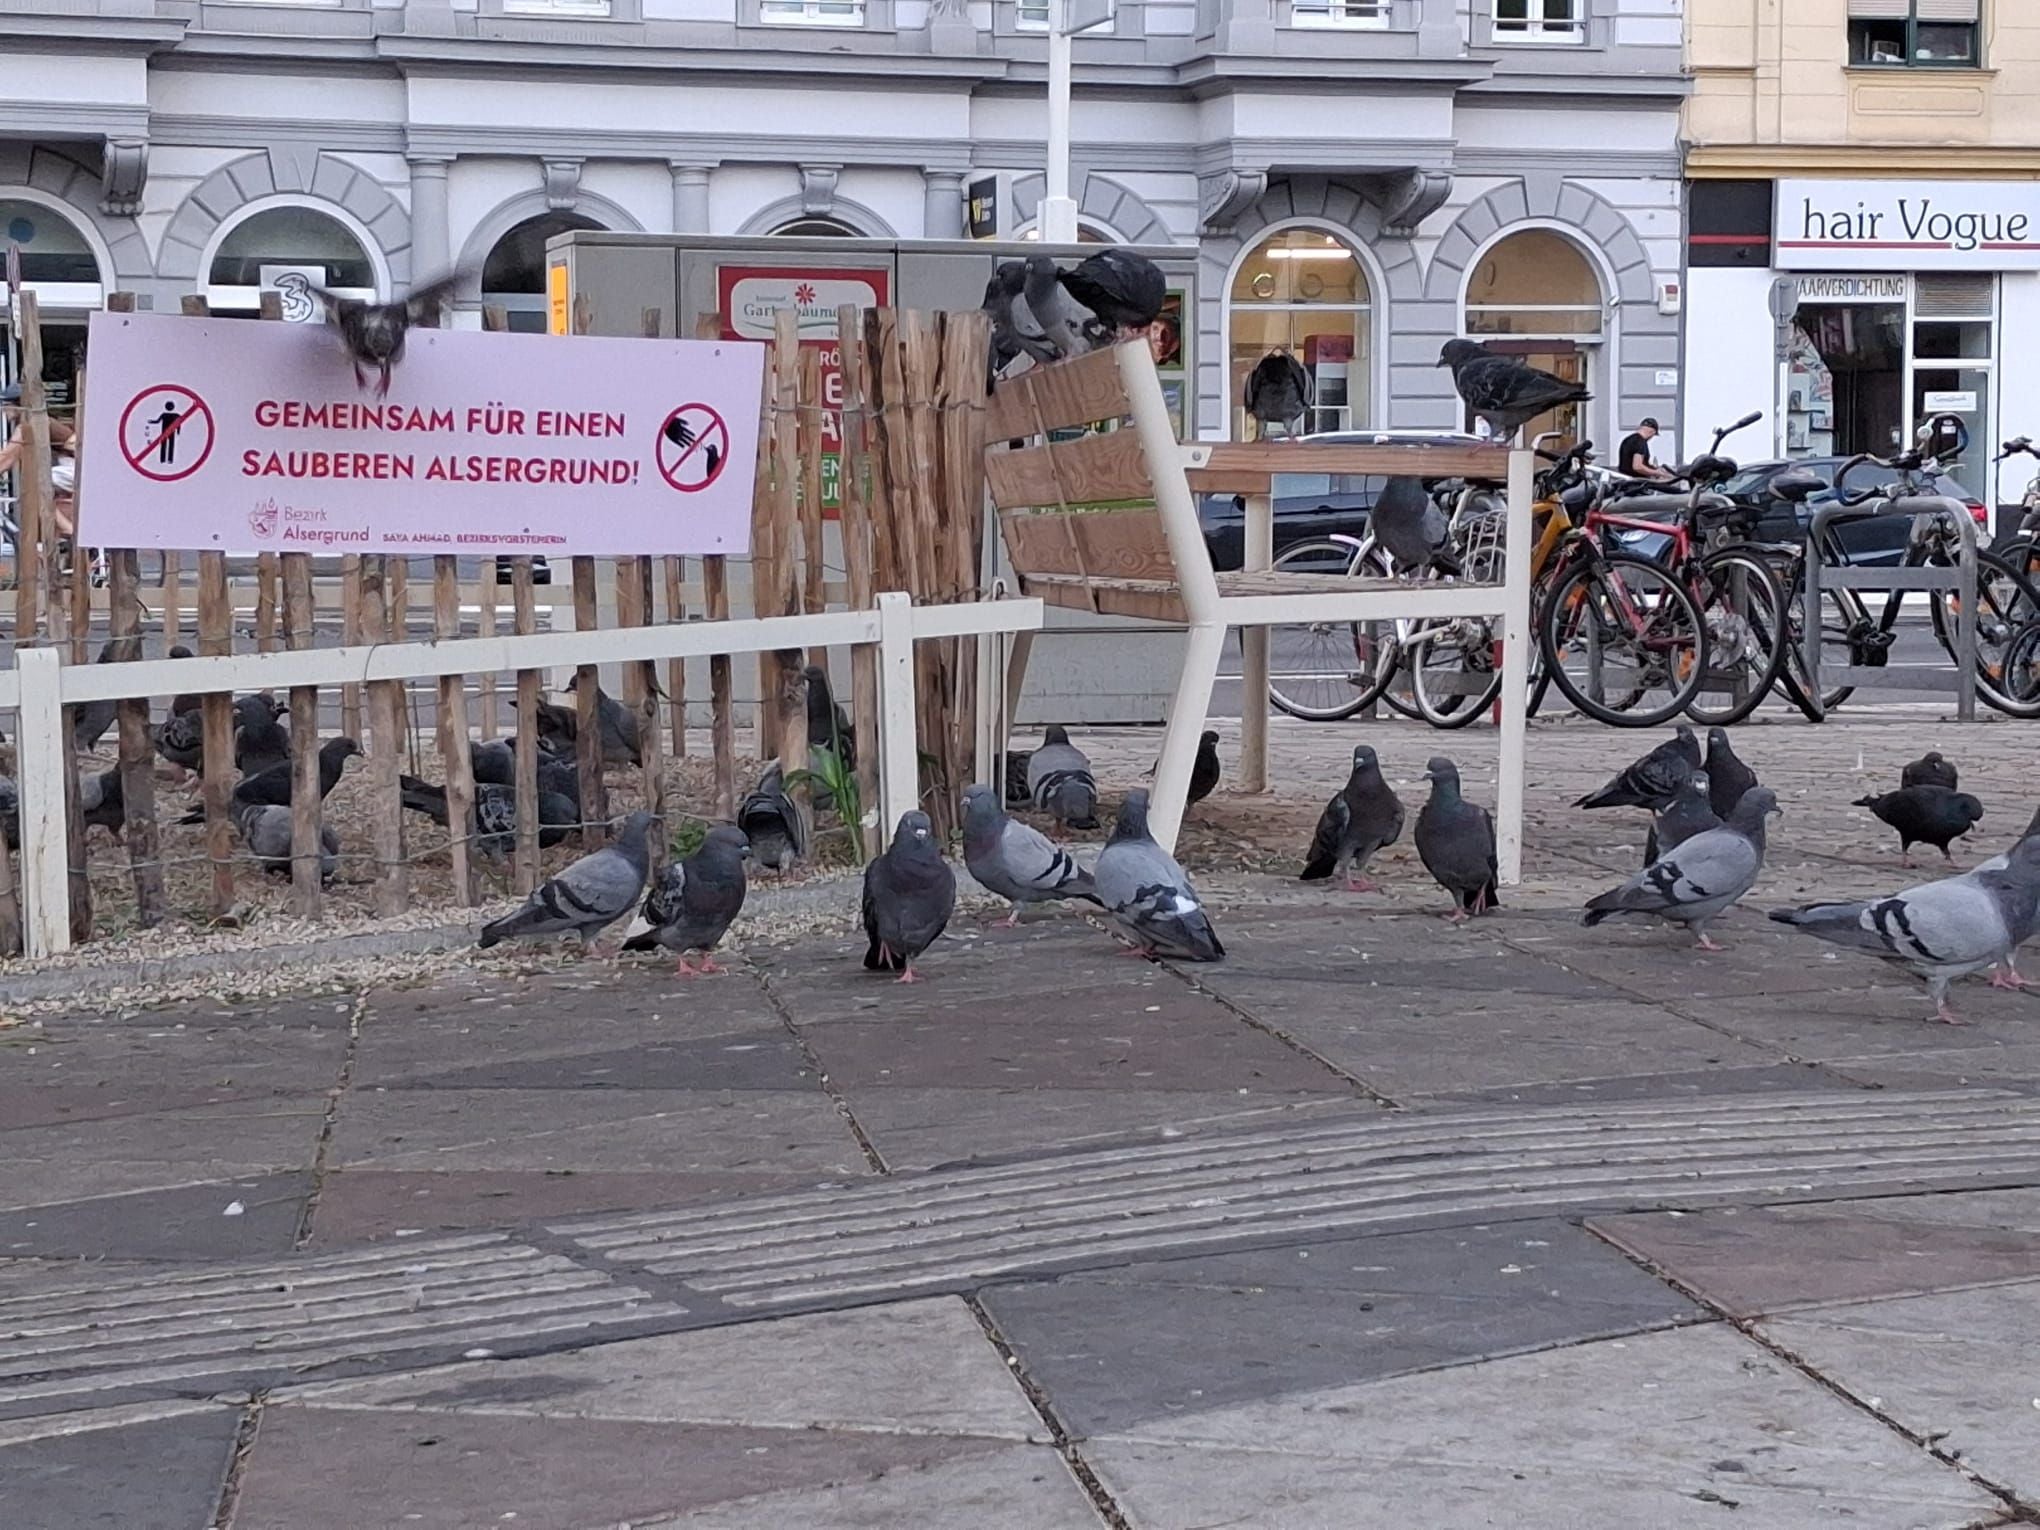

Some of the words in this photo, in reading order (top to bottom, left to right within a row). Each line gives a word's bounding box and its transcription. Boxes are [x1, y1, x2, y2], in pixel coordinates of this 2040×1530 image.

[1802, 198, 1883, 239] hair
[1898, 199, 2028, 250] Vogue
[273, 272, 314, 323] 3
[255, 400, 455, 432] GEMEINSAM
[467, 401, 525, 435] FÜR
[536, 411, 625, 437] EINEN
[242, 450, 414, 479] SAUBEREN
[424, 456, 639, 485] ALSERGRUND!
[285, 506, 328, 521] Bezirk
[283, 525, 370, 545] Alsergrund
